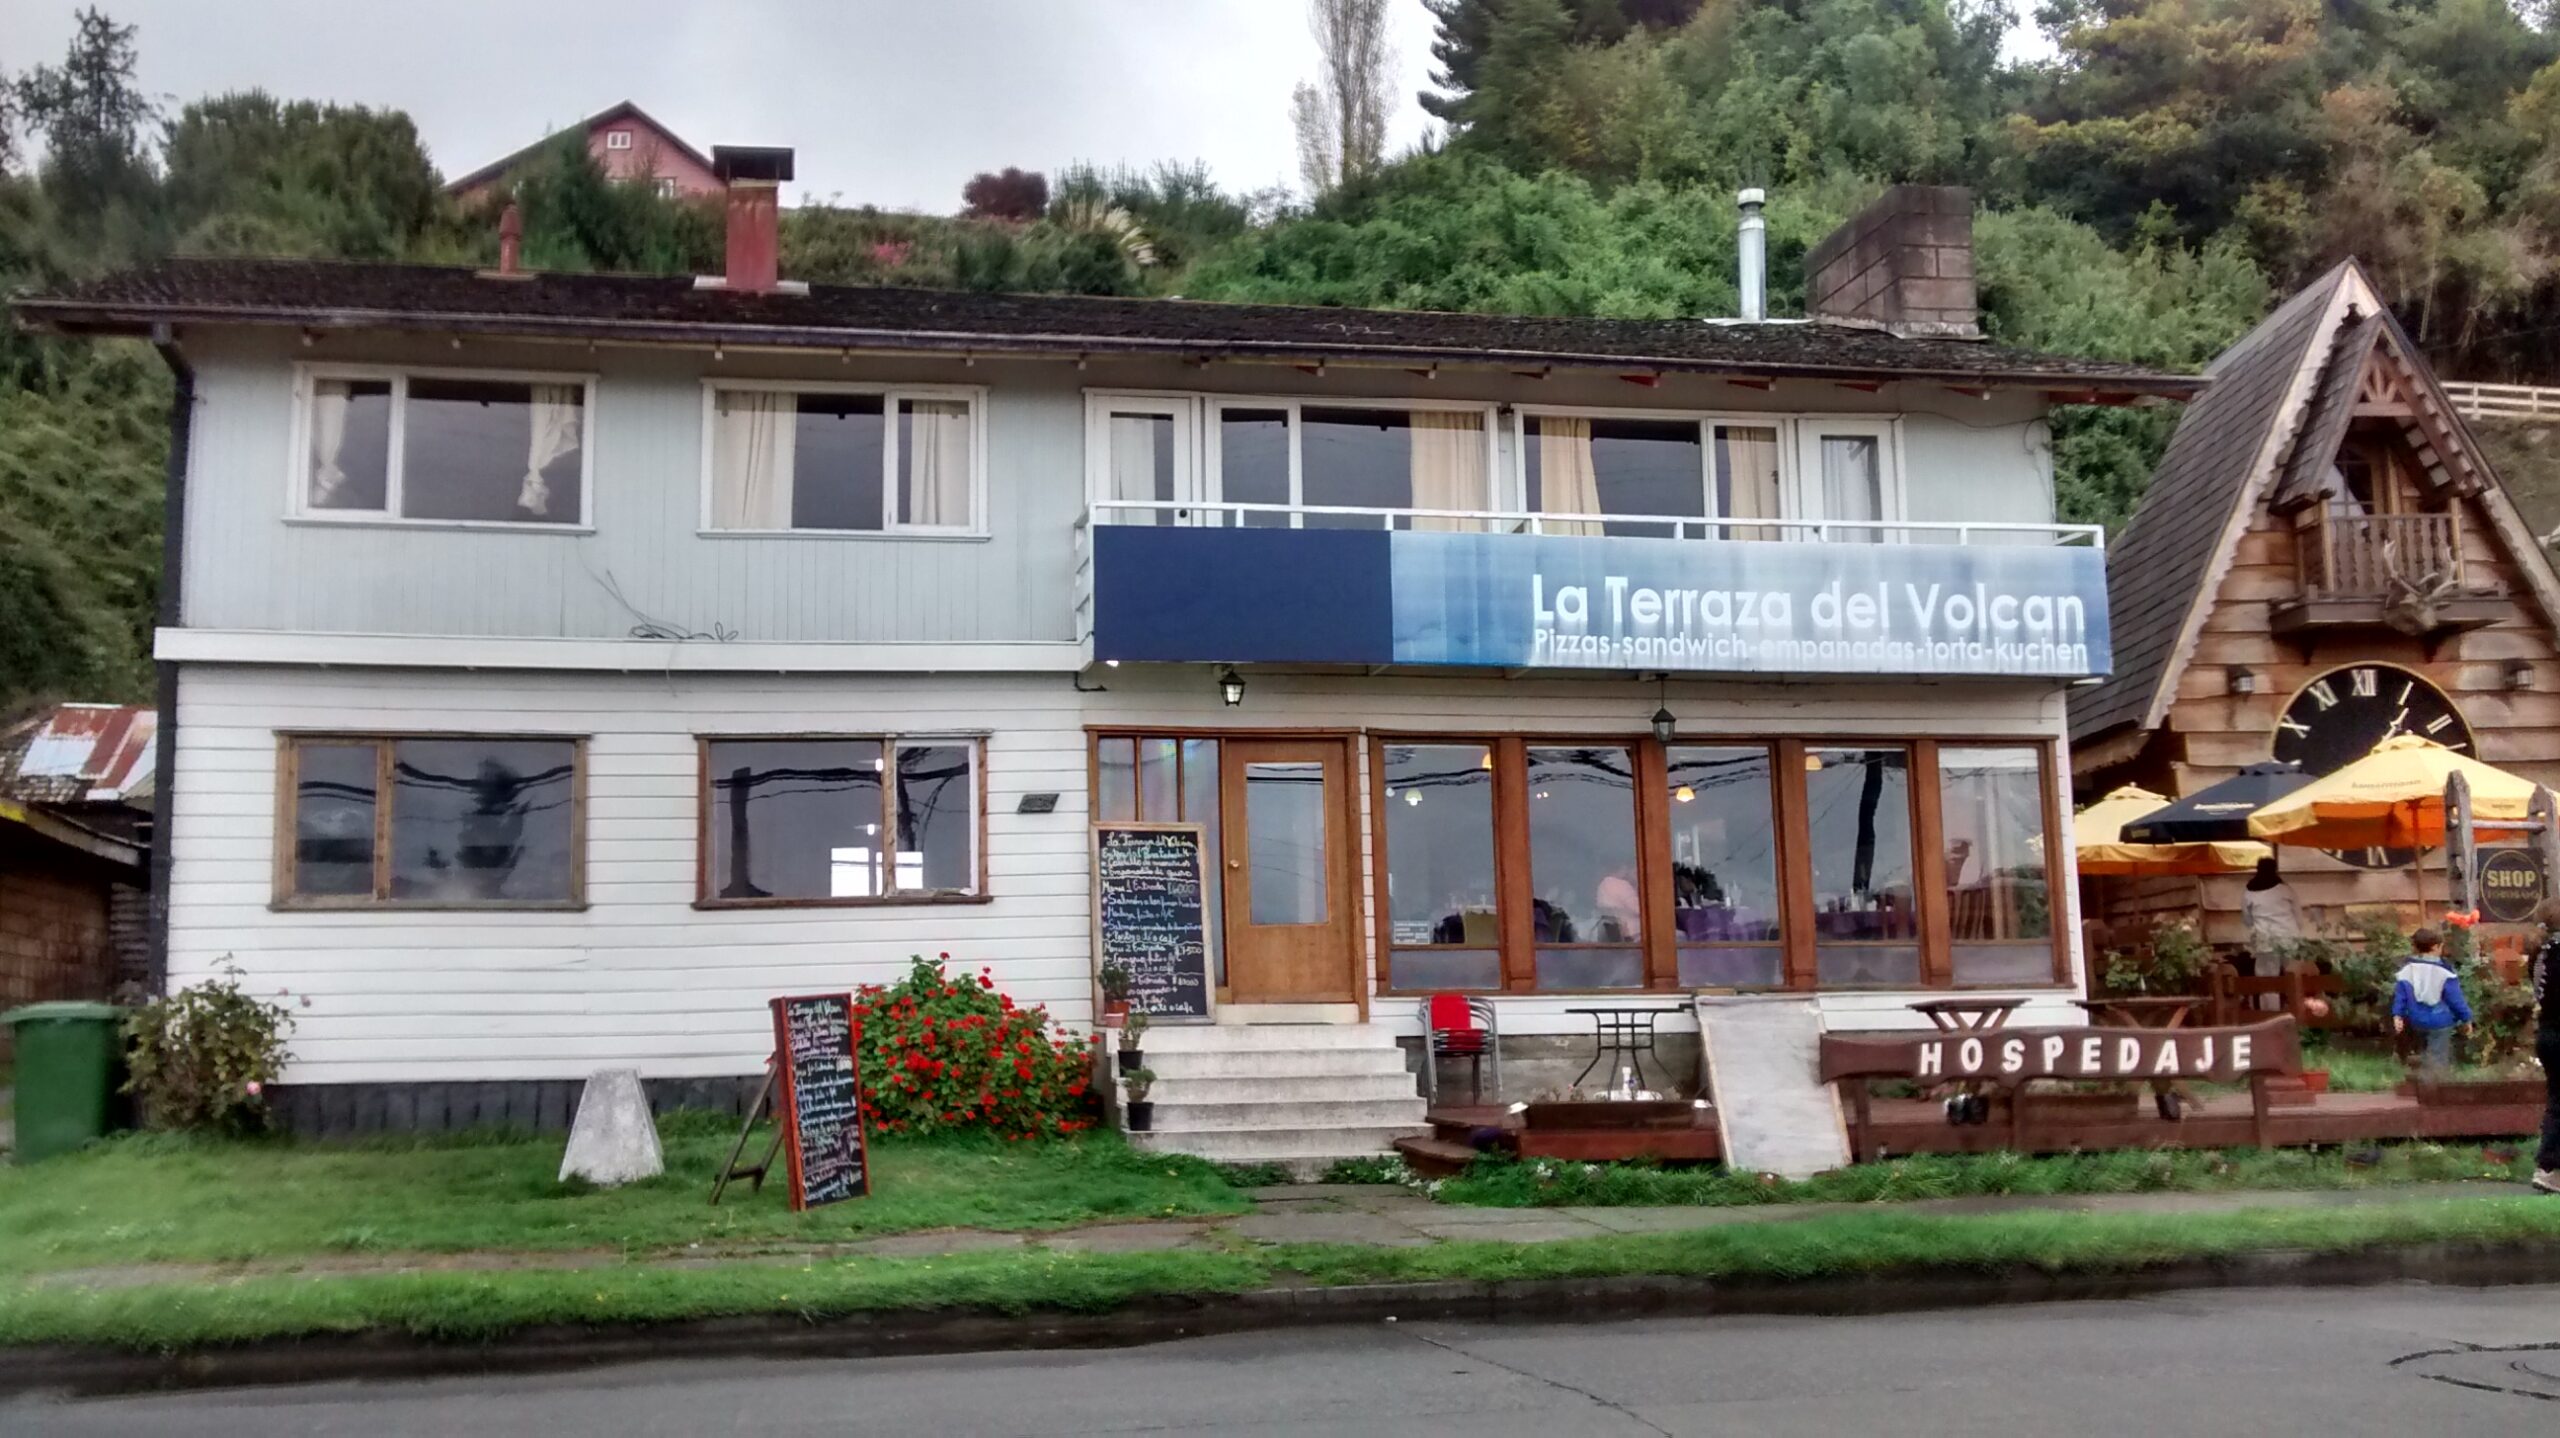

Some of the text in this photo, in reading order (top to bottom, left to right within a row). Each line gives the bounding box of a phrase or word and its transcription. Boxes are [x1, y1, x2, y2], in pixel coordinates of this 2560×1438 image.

[1532, 573, 2085, 631] La Terraza del Volcan
[2487, 870, 2536, 888] SHOP
[1918, 1033, 2252, 1075] HOSPEDAJE
